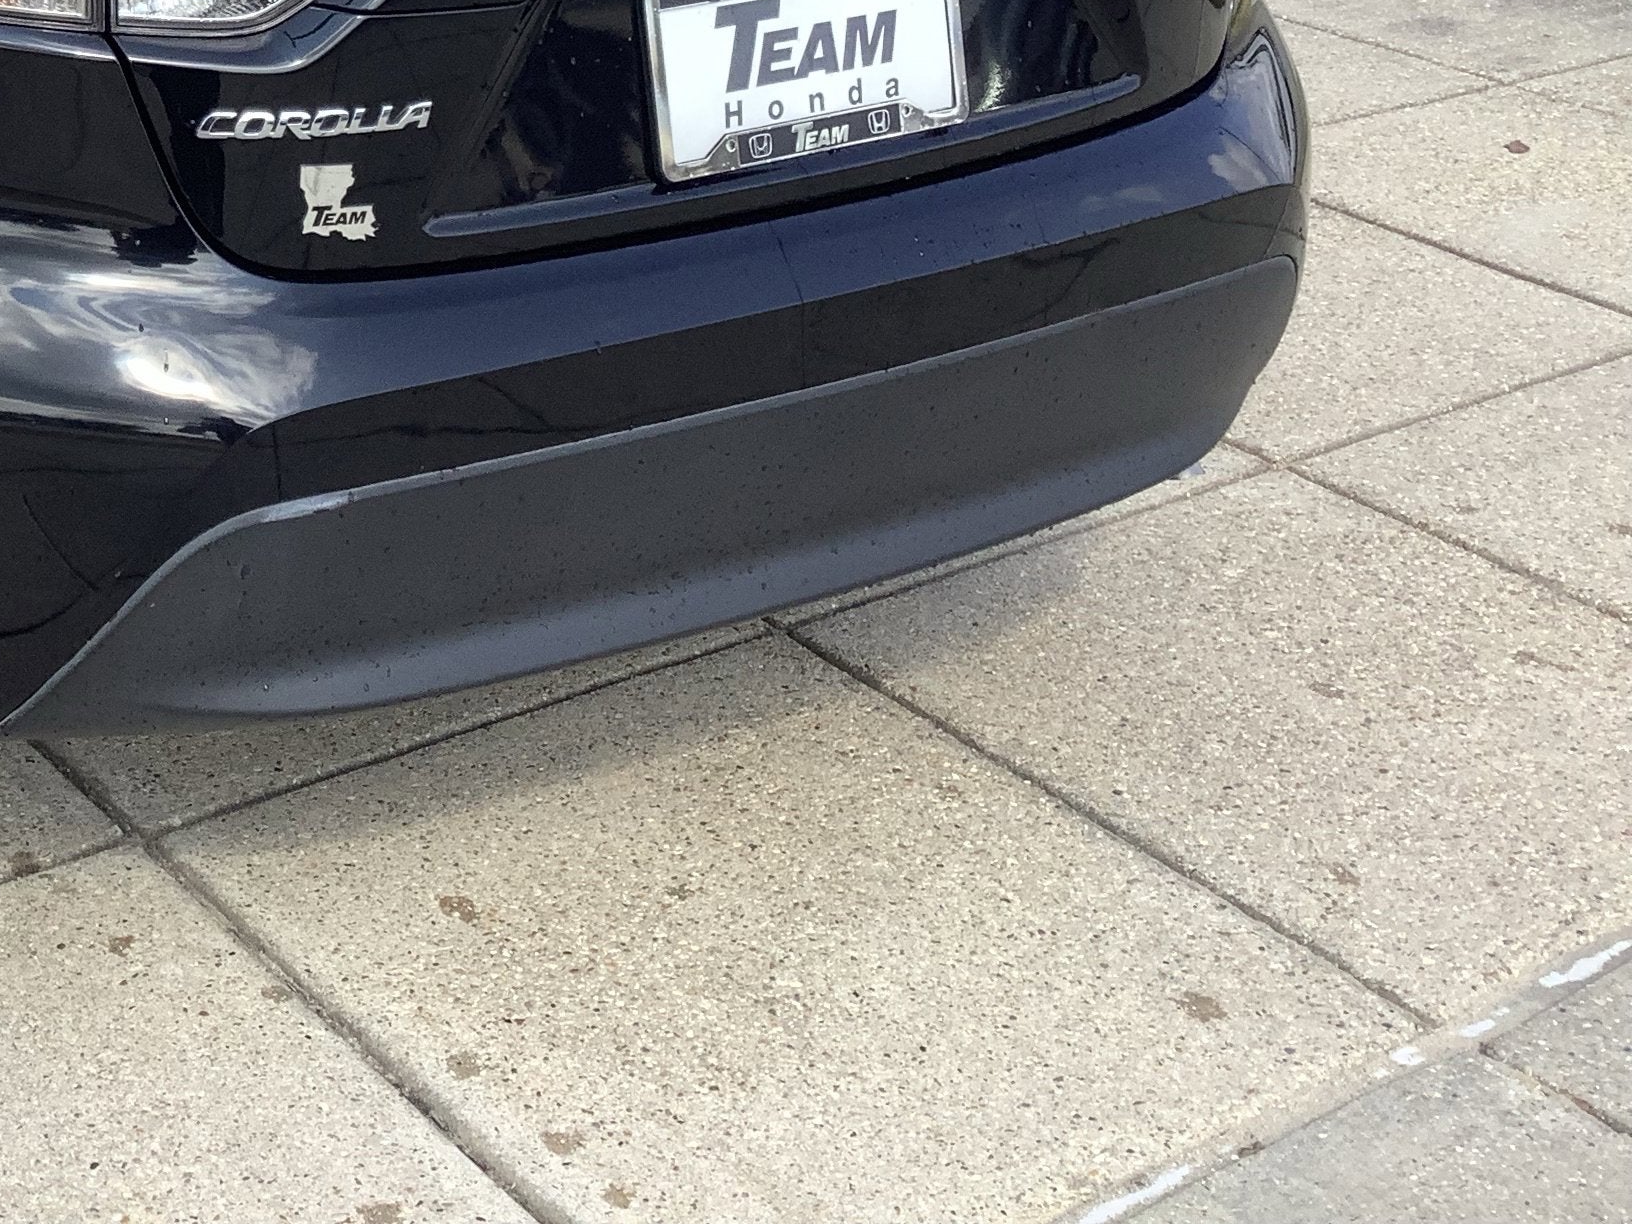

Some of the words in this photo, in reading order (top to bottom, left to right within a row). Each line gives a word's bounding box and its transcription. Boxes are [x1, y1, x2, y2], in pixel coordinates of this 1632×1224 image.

[196, 101, 433, 140] COROLLA
[724, 77, 901, 129] Honda
[791, 121, 850, 153] TEAM
[312, 205, 368, 227] TEAM
